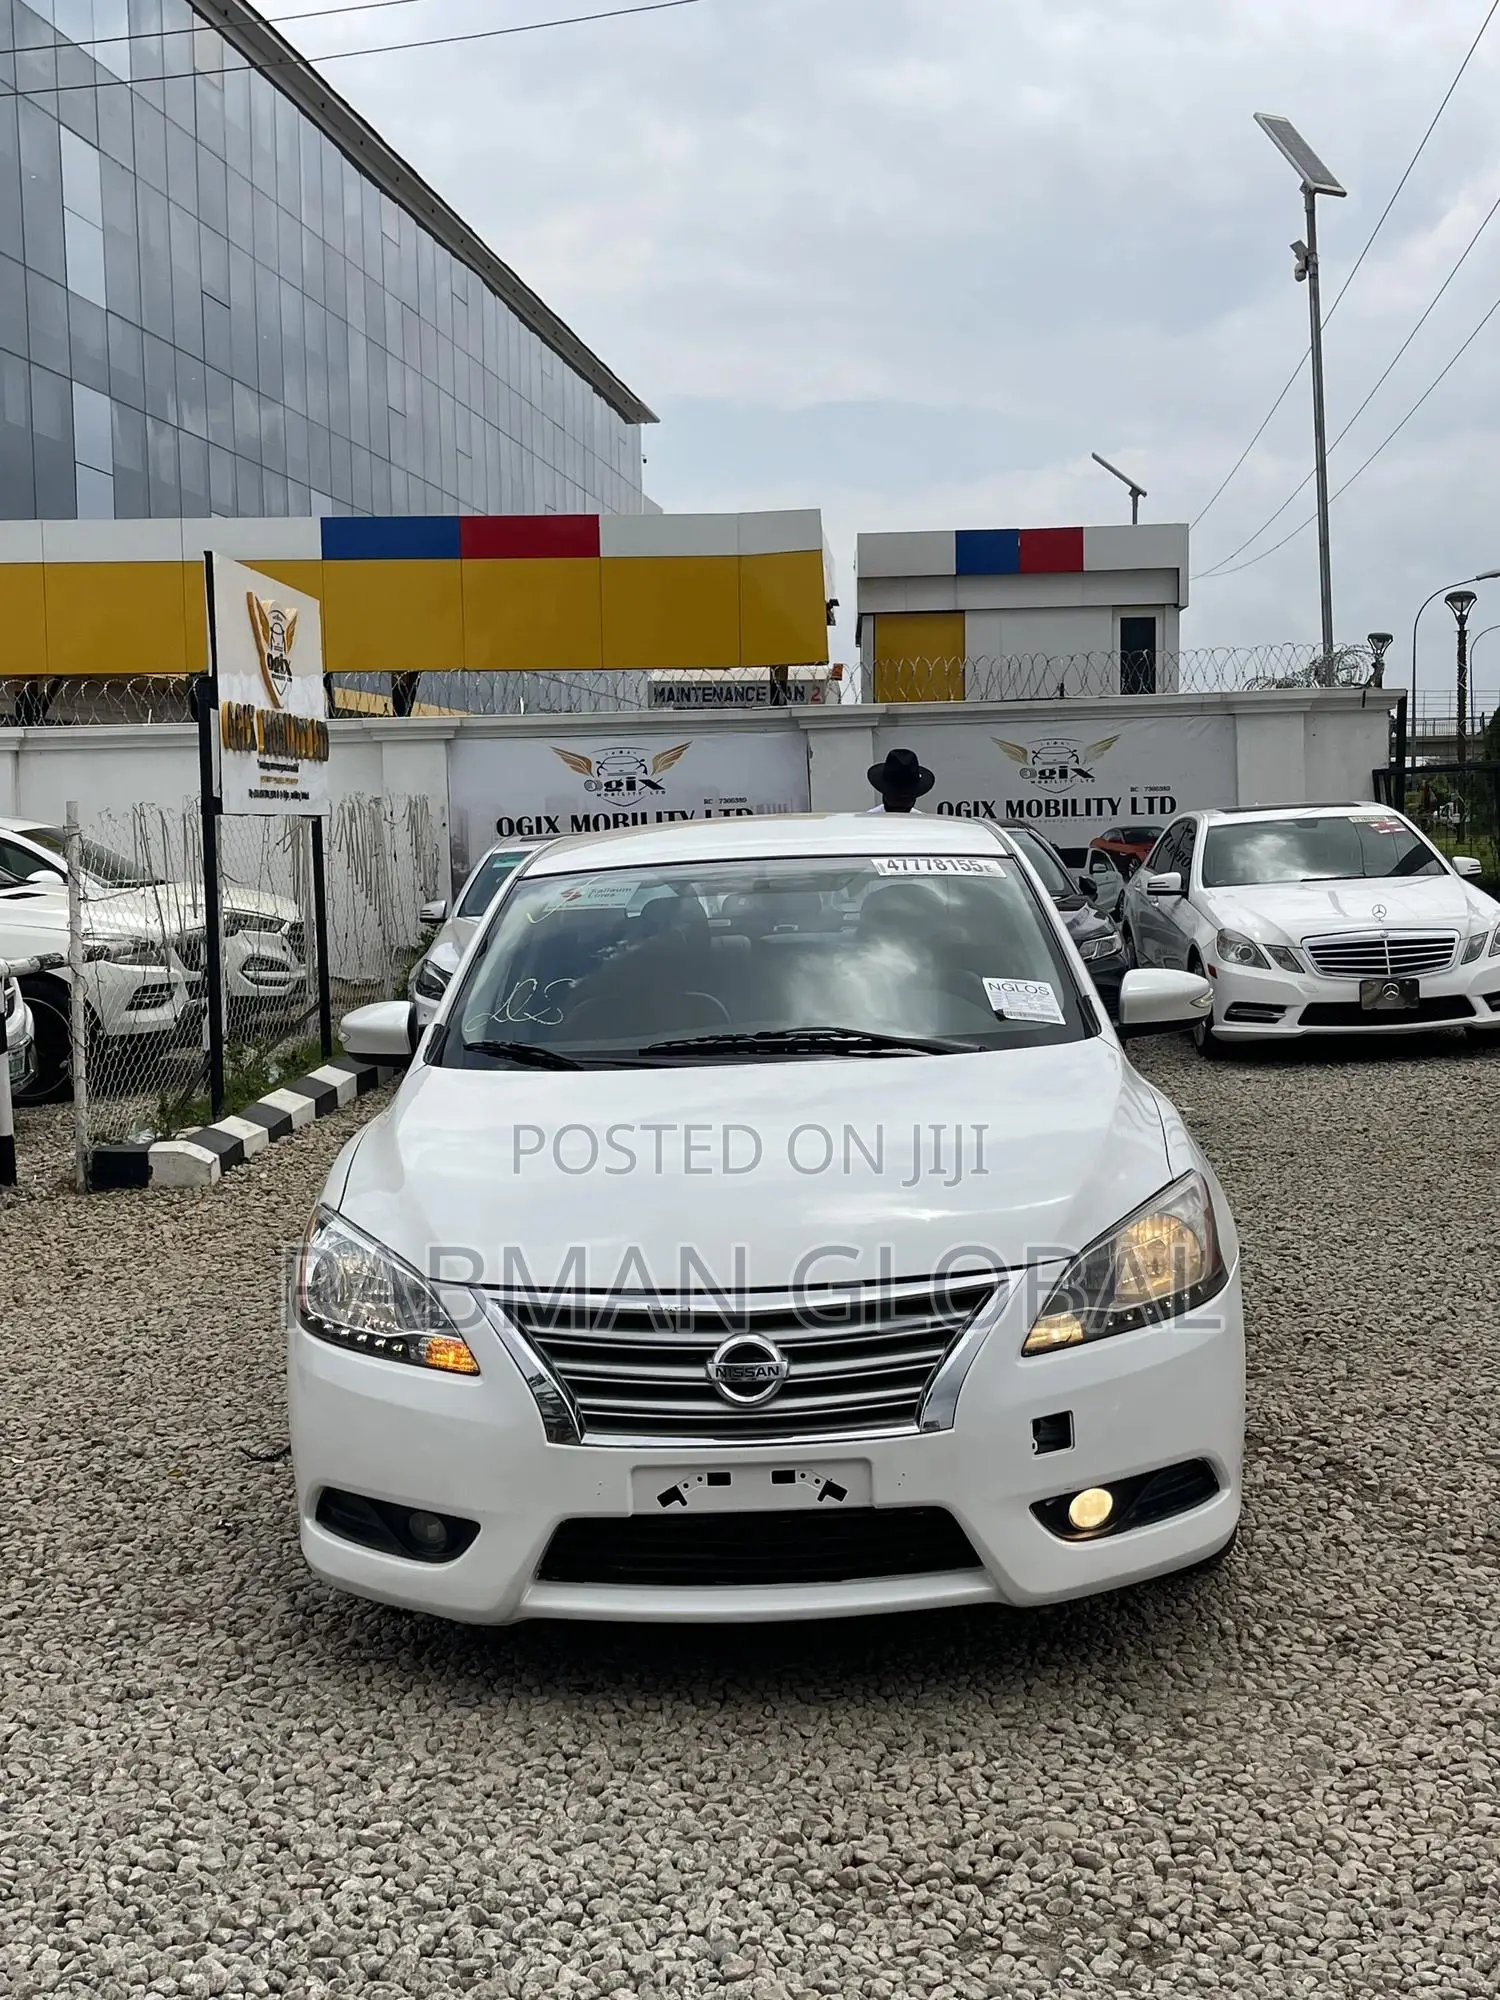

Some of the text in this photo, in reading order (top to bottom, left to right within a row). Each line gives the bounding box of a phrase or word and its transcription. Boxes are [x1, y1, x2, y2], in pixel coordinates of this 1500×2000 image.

[653, 685, 767, 703] MAINTENANCE
[810, 686, 822, 704] 2
[937, 795, 1177, 819] OGIX MOBILITY LTD
[496, 815, 560, 838] OGIX
[988, 982, 1050, 996] NGLOS
[715, 1365, 780, 1378] NISSAN
